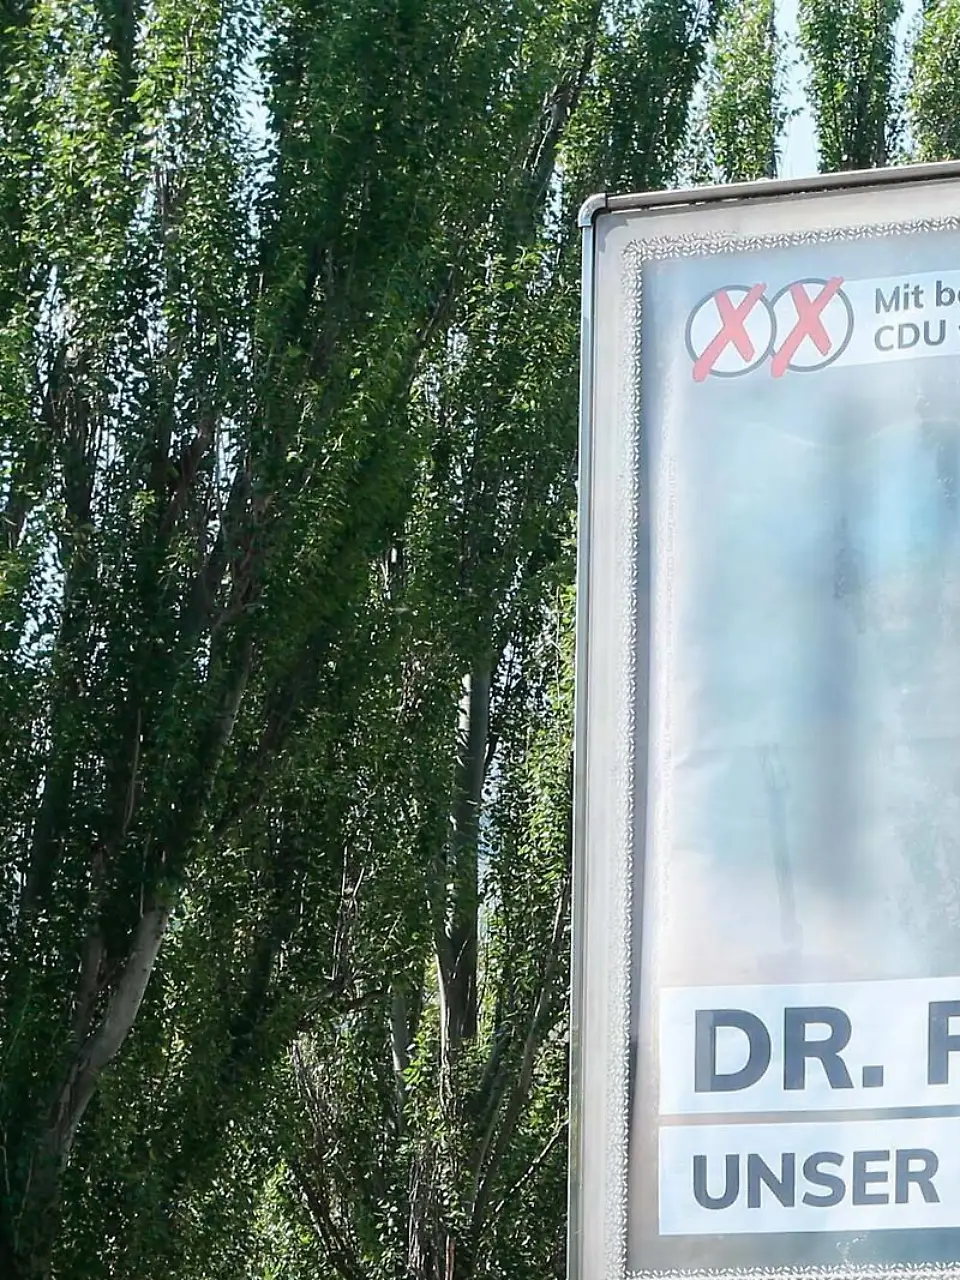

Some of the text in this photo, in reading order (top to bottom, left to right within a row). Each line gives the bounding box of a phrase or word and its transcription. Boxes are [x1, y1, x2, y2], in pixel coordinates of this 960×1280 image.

[875, 284, 924, 314] Mit
[874, 319, 946, 352] CDU
[694, 1006, 884, 1093] DR.
[692, 1148, 940, 1210] UNSER
